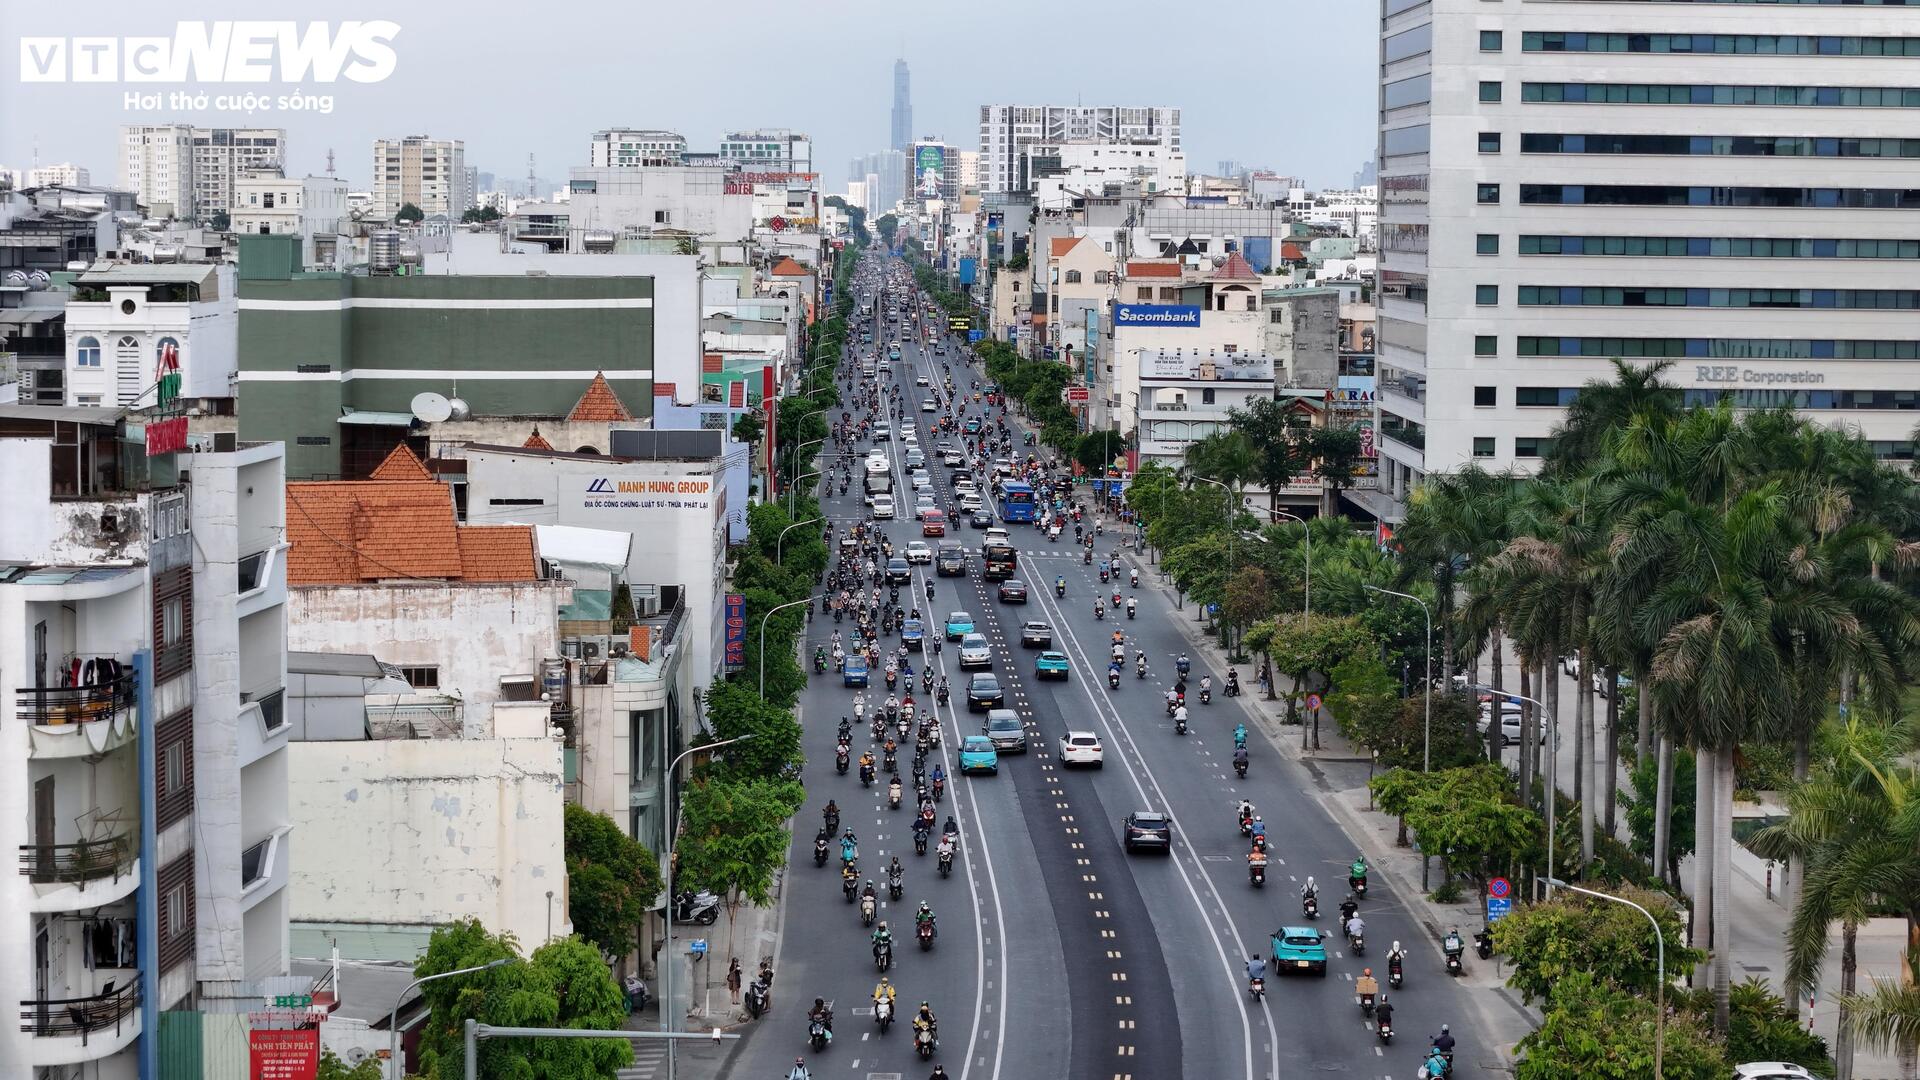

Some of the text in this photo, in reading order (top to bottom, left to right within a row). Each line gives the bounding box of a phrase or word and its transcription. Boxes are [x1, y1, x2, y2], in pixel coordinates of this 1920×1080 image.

[725, 183, 752, 195] HOTEL
[1118, 307, 1196, 322] Sacombank
[1695, 366, 1825, 384] REE Corporation
[677, 481, 709, 493] GROUP
[251, 1042, 274, 1052] MẠNH
[294, 1040, 314, 1050] PHÁT
